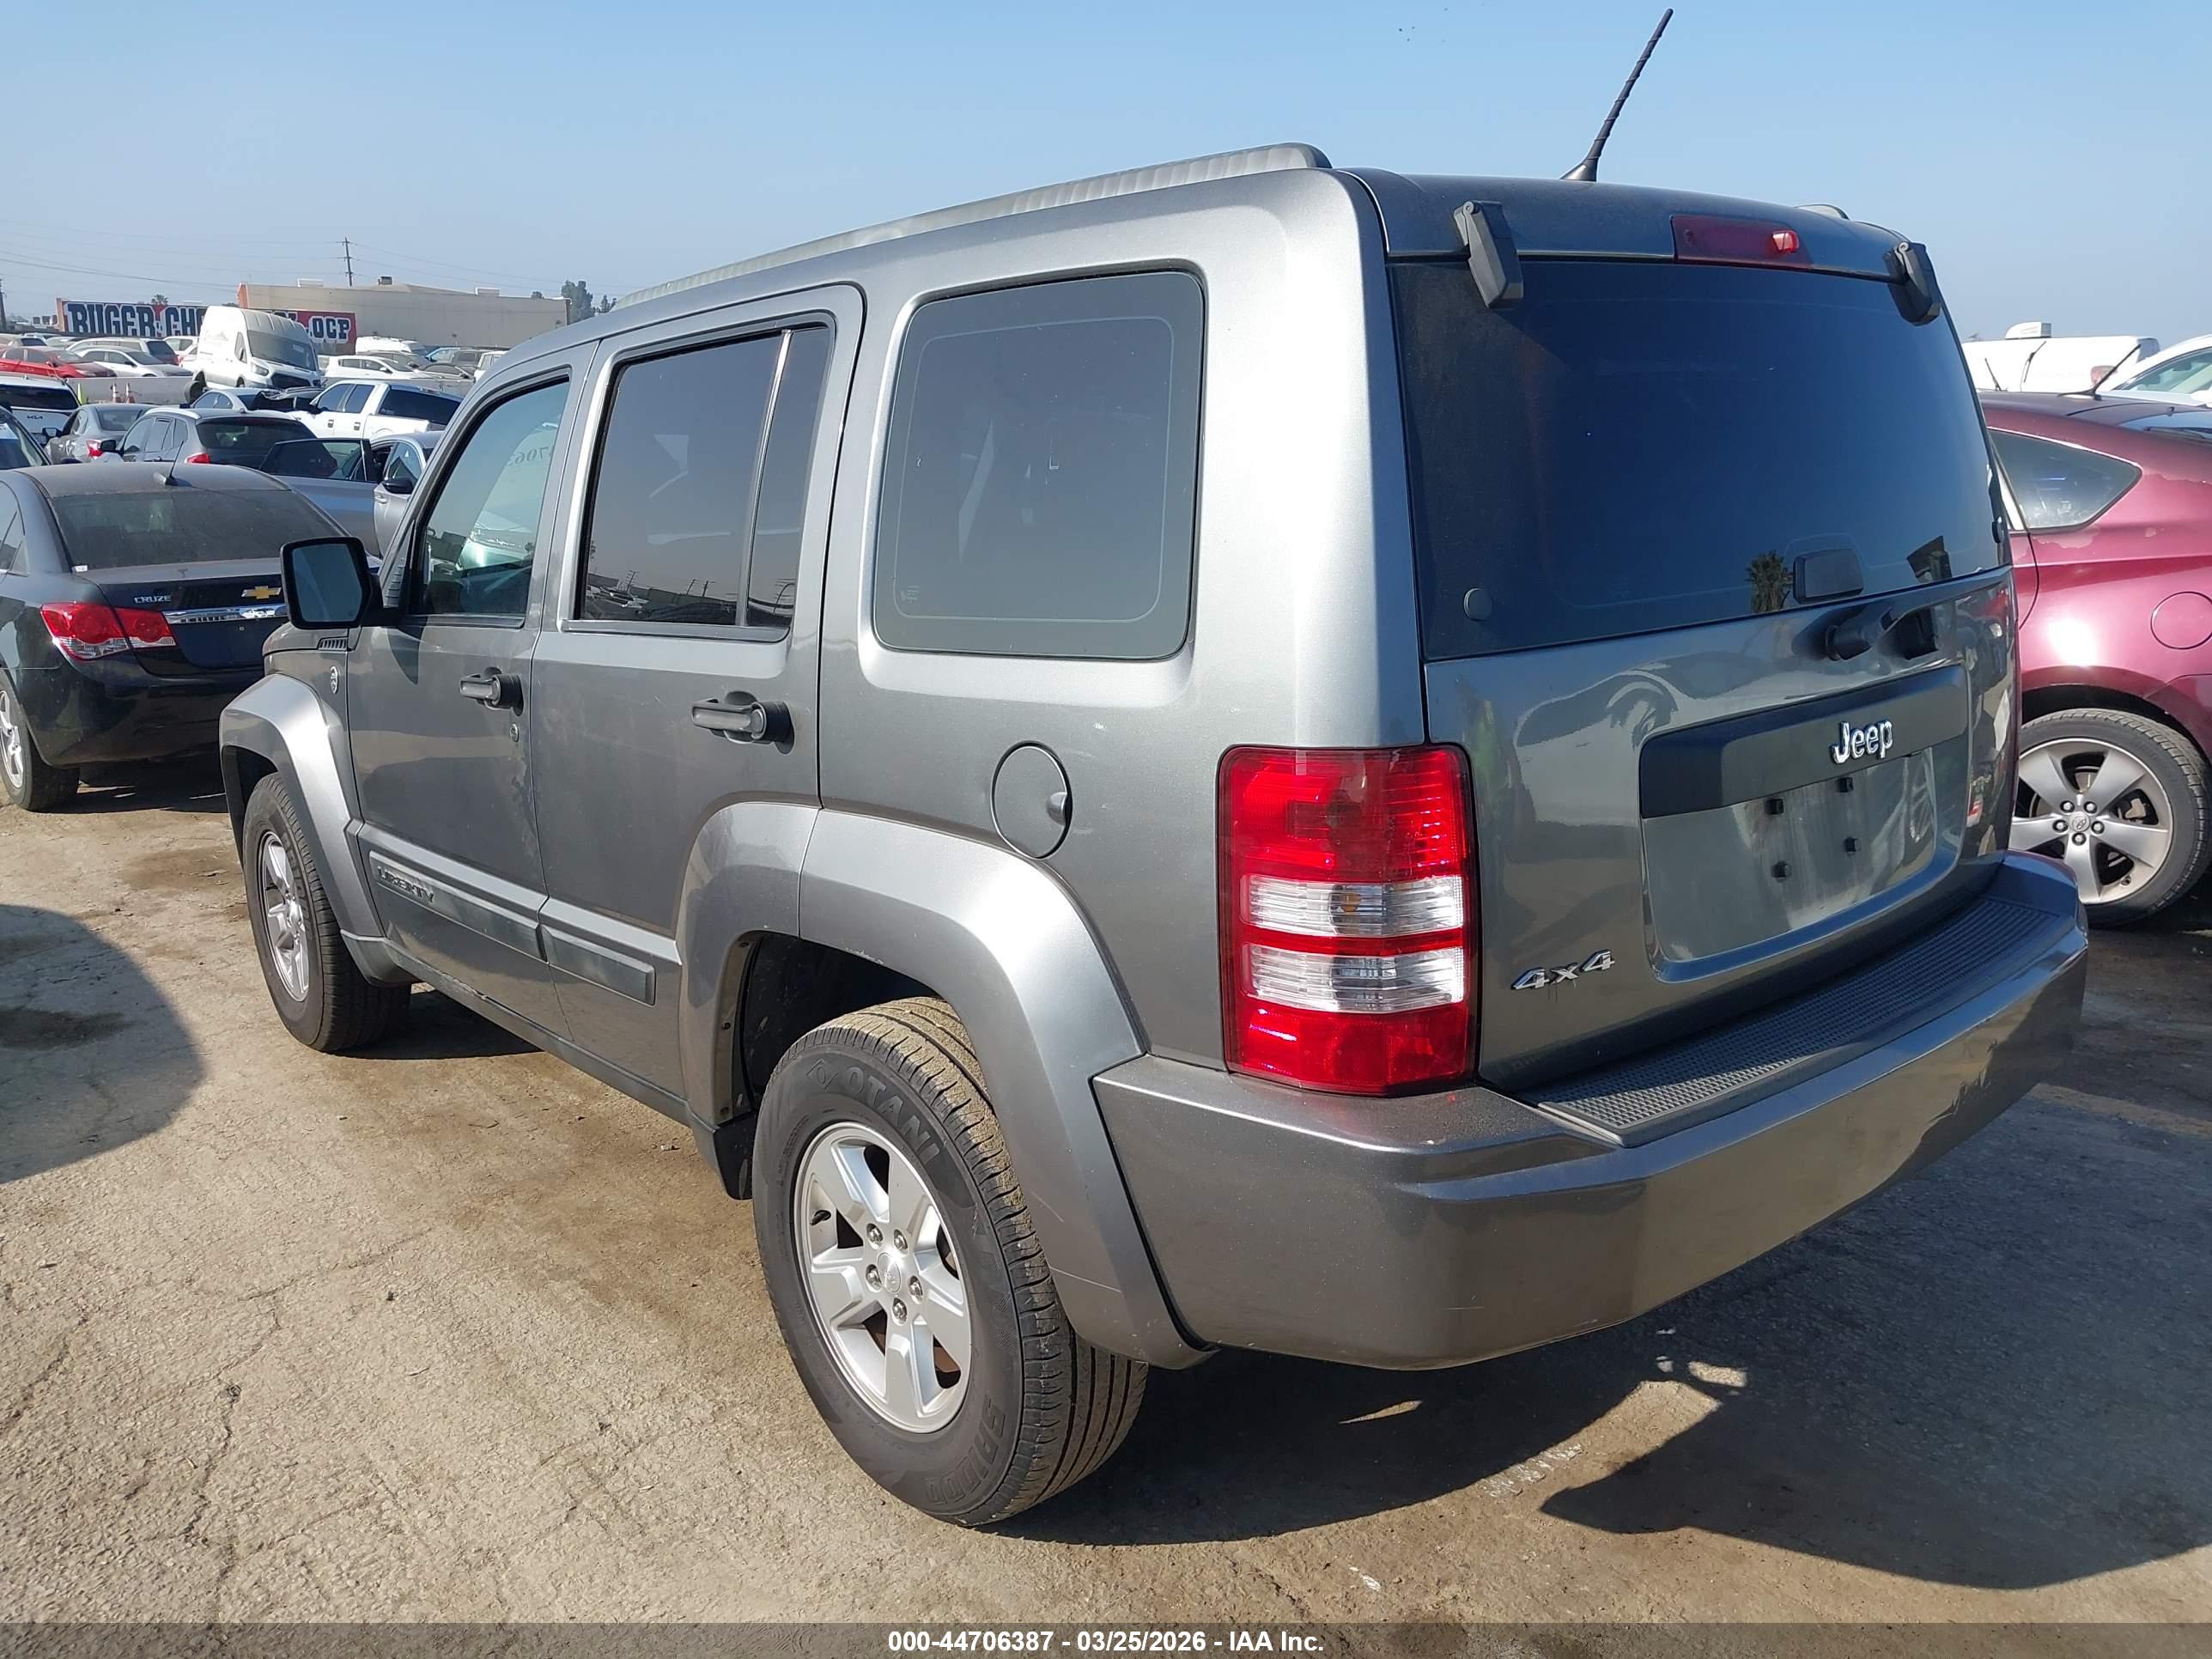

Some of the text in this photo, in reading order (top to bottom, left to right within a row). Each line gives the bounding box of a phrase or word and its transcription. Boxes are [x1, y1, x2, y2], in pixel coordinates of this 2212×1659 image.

[134, 594, 172, 604] CRUZE
[1831, 720, 1893, 763] Jeep
[1511, 949, 1615, 989] 4x4
[845, 1066, 940, 1166] OTANI
